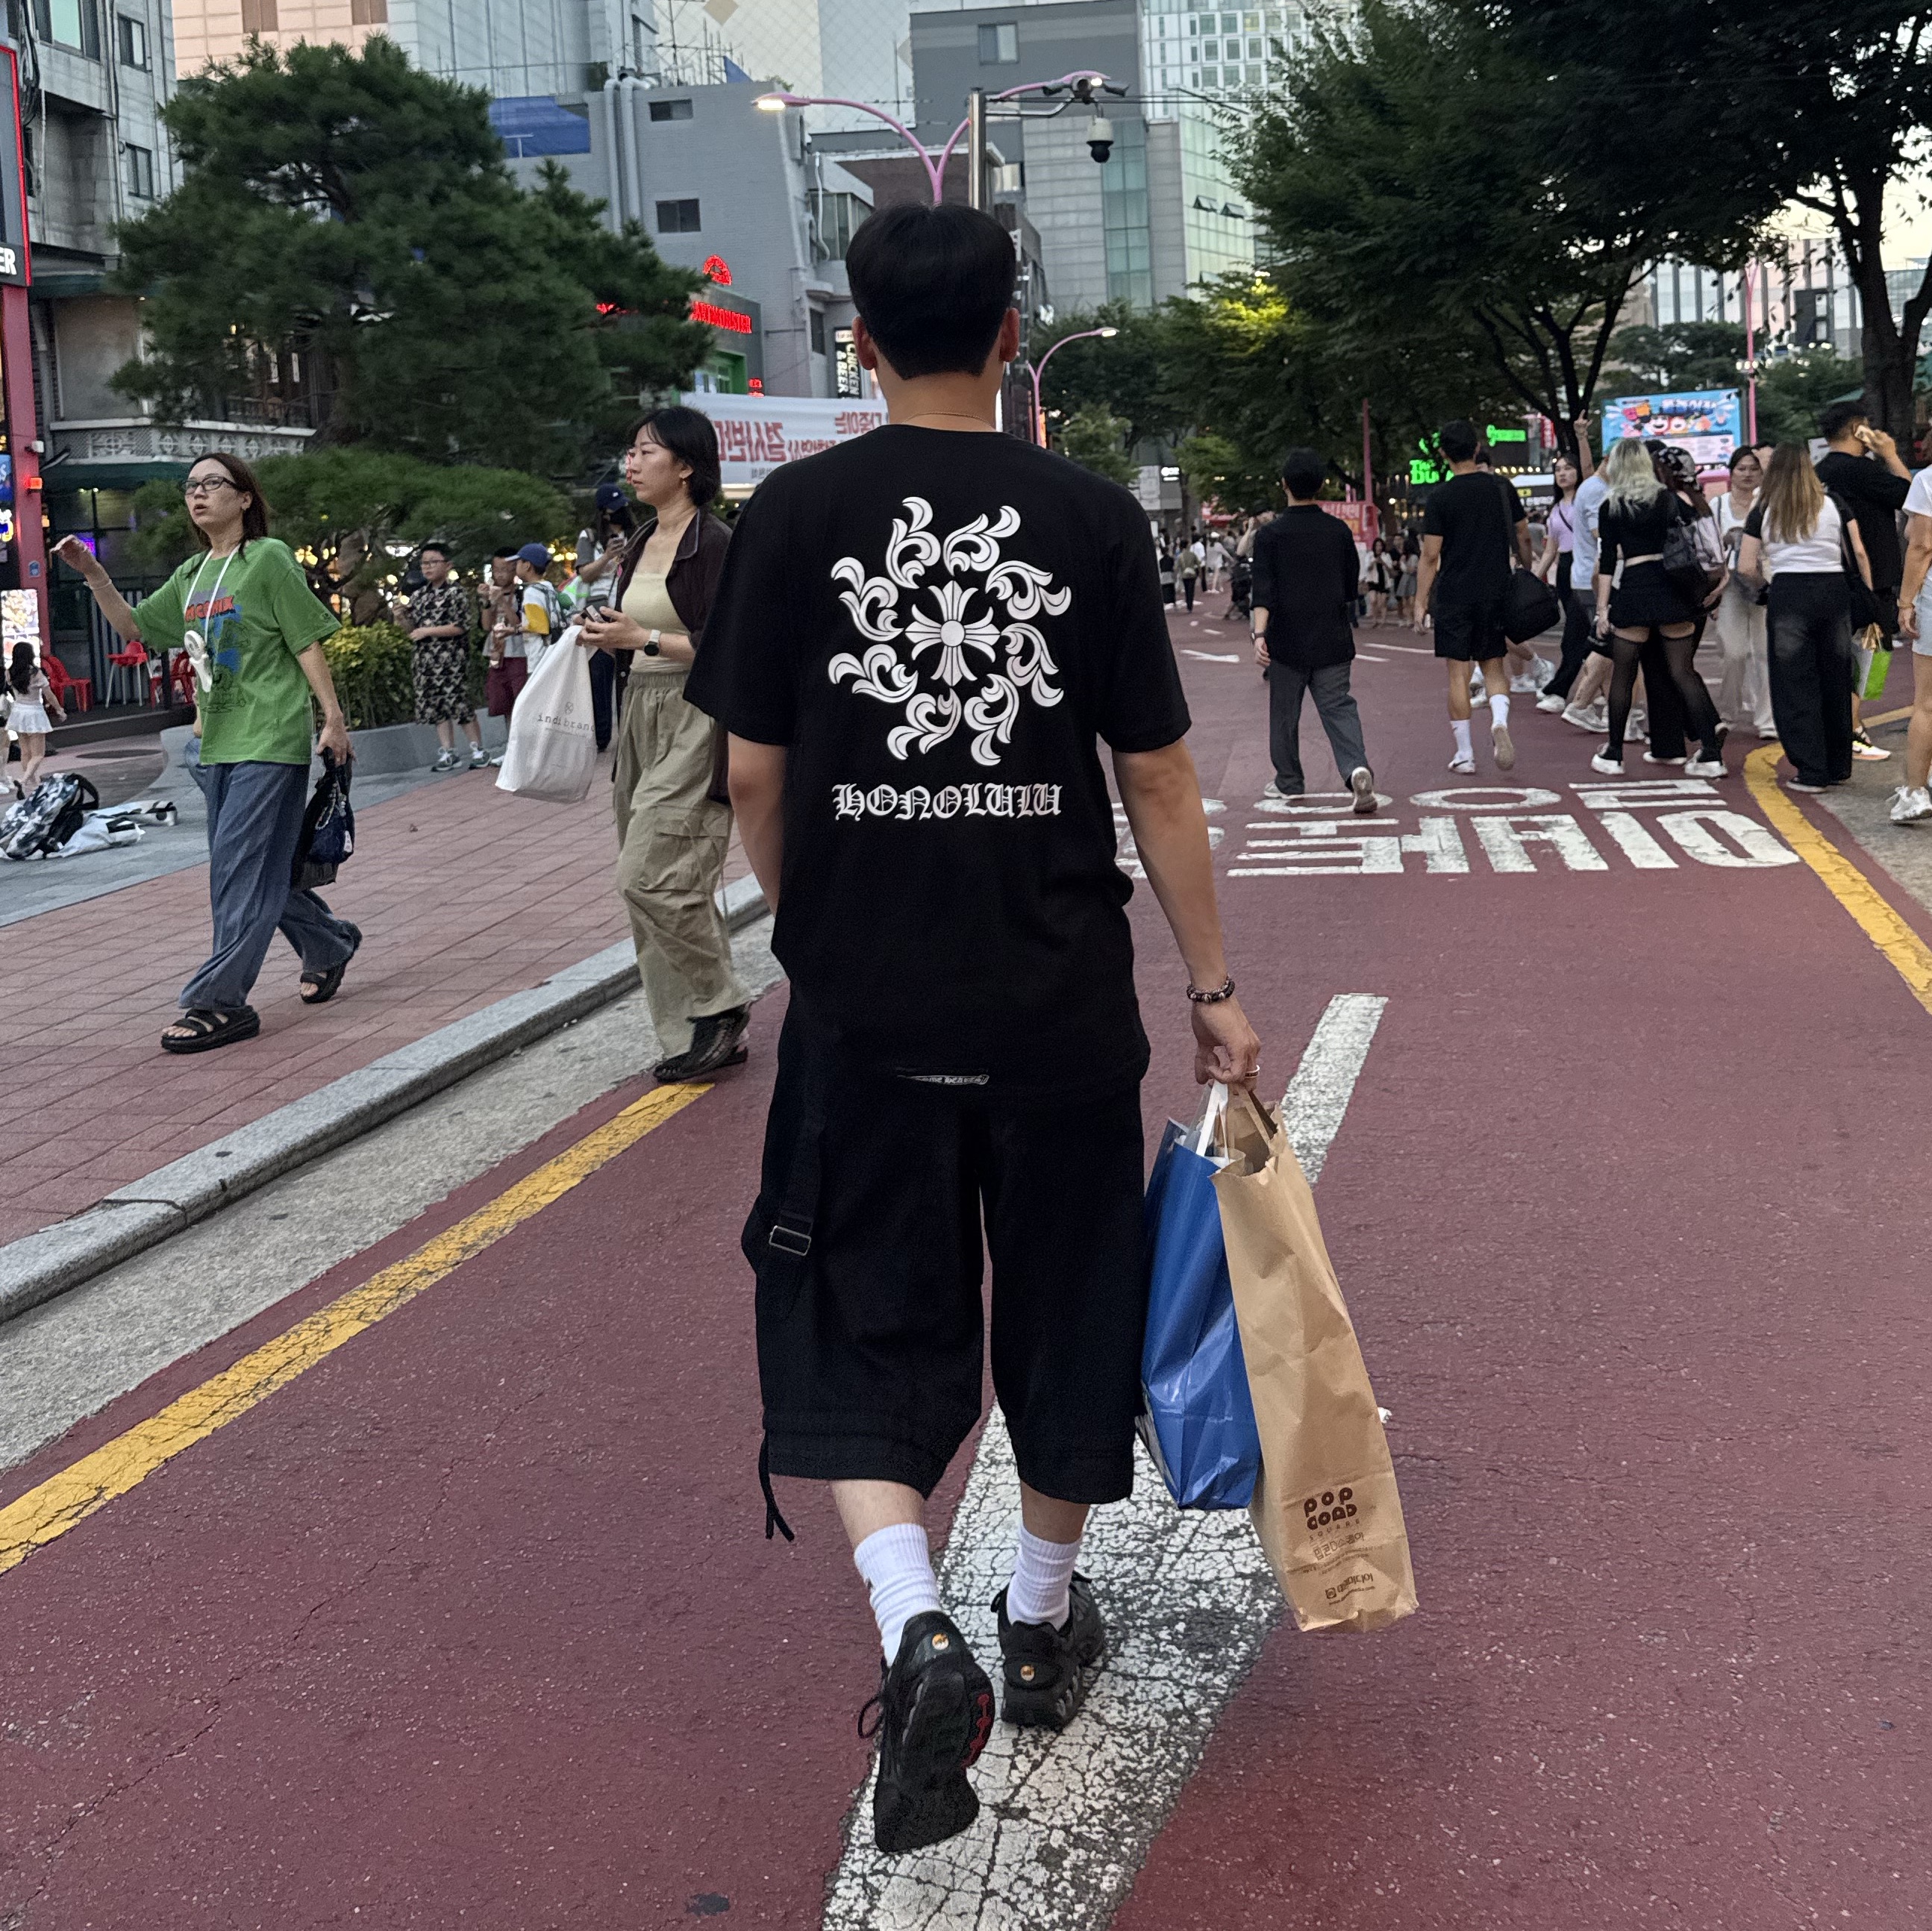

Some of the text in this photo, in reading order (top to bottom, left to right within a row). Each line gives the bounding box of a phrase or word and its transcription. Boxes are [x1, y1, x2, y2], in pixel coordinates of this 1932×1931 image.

[837, 360, 849, 393] BEER
[831, 783, 1063, 821] HONOLULU
[1309, 1520, 1360, 1542] SQUARE
